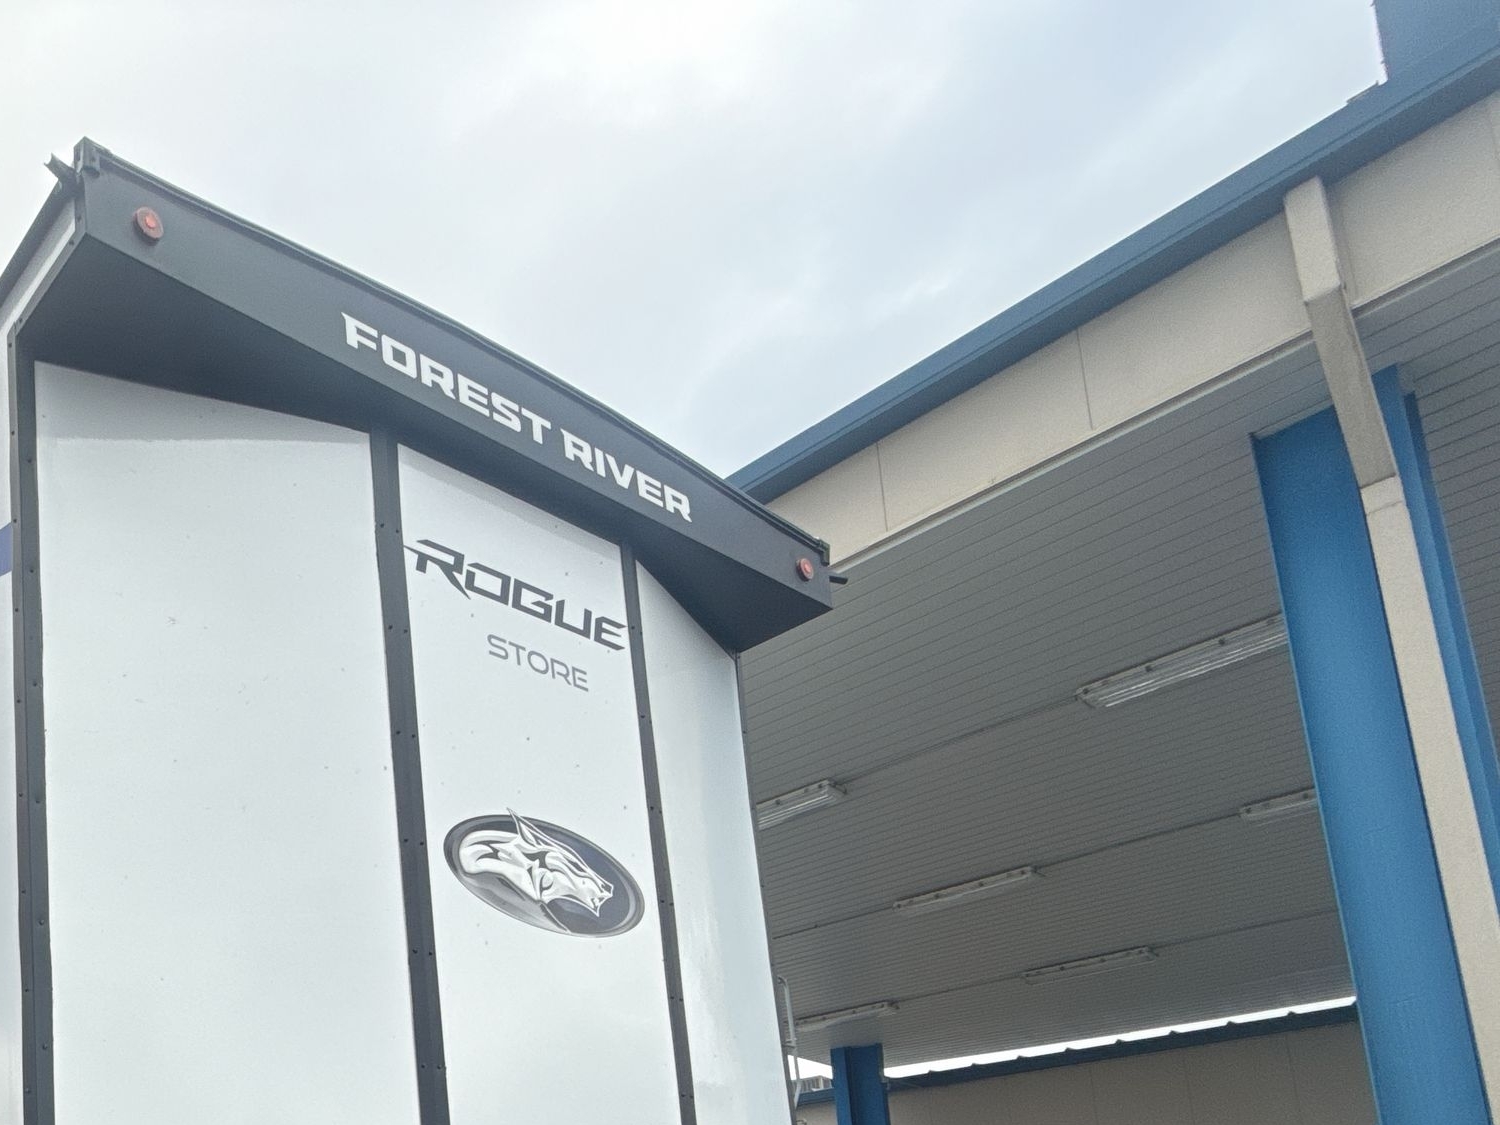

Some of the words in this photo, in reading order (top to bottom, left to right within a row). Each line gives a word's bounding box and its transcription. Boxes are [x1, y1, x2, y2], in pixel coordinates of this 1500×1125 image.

[341, 312, 551, 445] FOREST
[560, 427, 692, 523] RIVER
[402, 539, 628, 651] ROGUE
[487, 634, 589, 692] STORE
